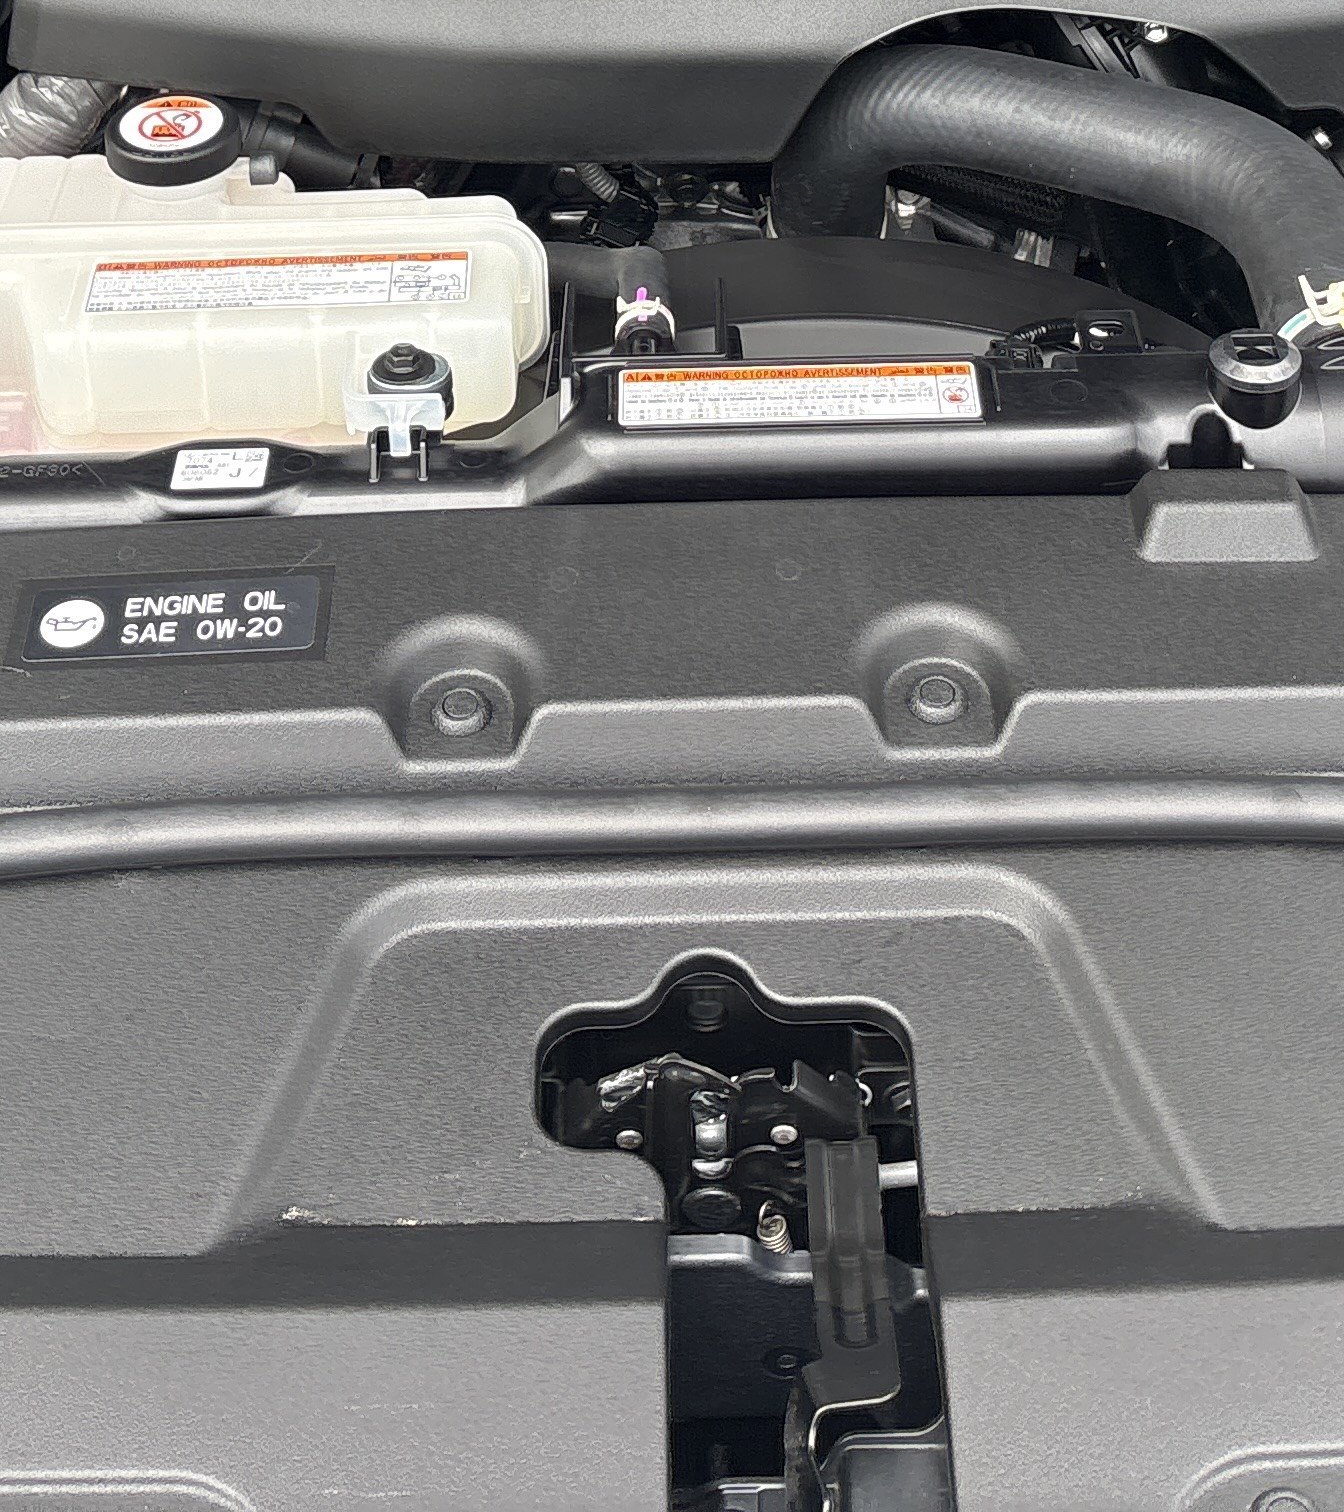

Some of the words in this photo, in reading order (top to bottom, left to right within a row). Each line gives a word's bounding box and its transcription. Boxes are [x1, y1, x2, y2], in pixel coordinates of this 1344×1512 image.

[281, 254, 363, 265] AVERTISSEMENT
[683, 370, 729, 381] WARNING
[803, 367, 884, 378] AVERTISSEMENT
[123, 591, 227, 619] ENGINE
[242, 589, 287, 612] OIL
[119, 620, 179, 645] SAE
[195, 615, 284, 641] 0W-20
